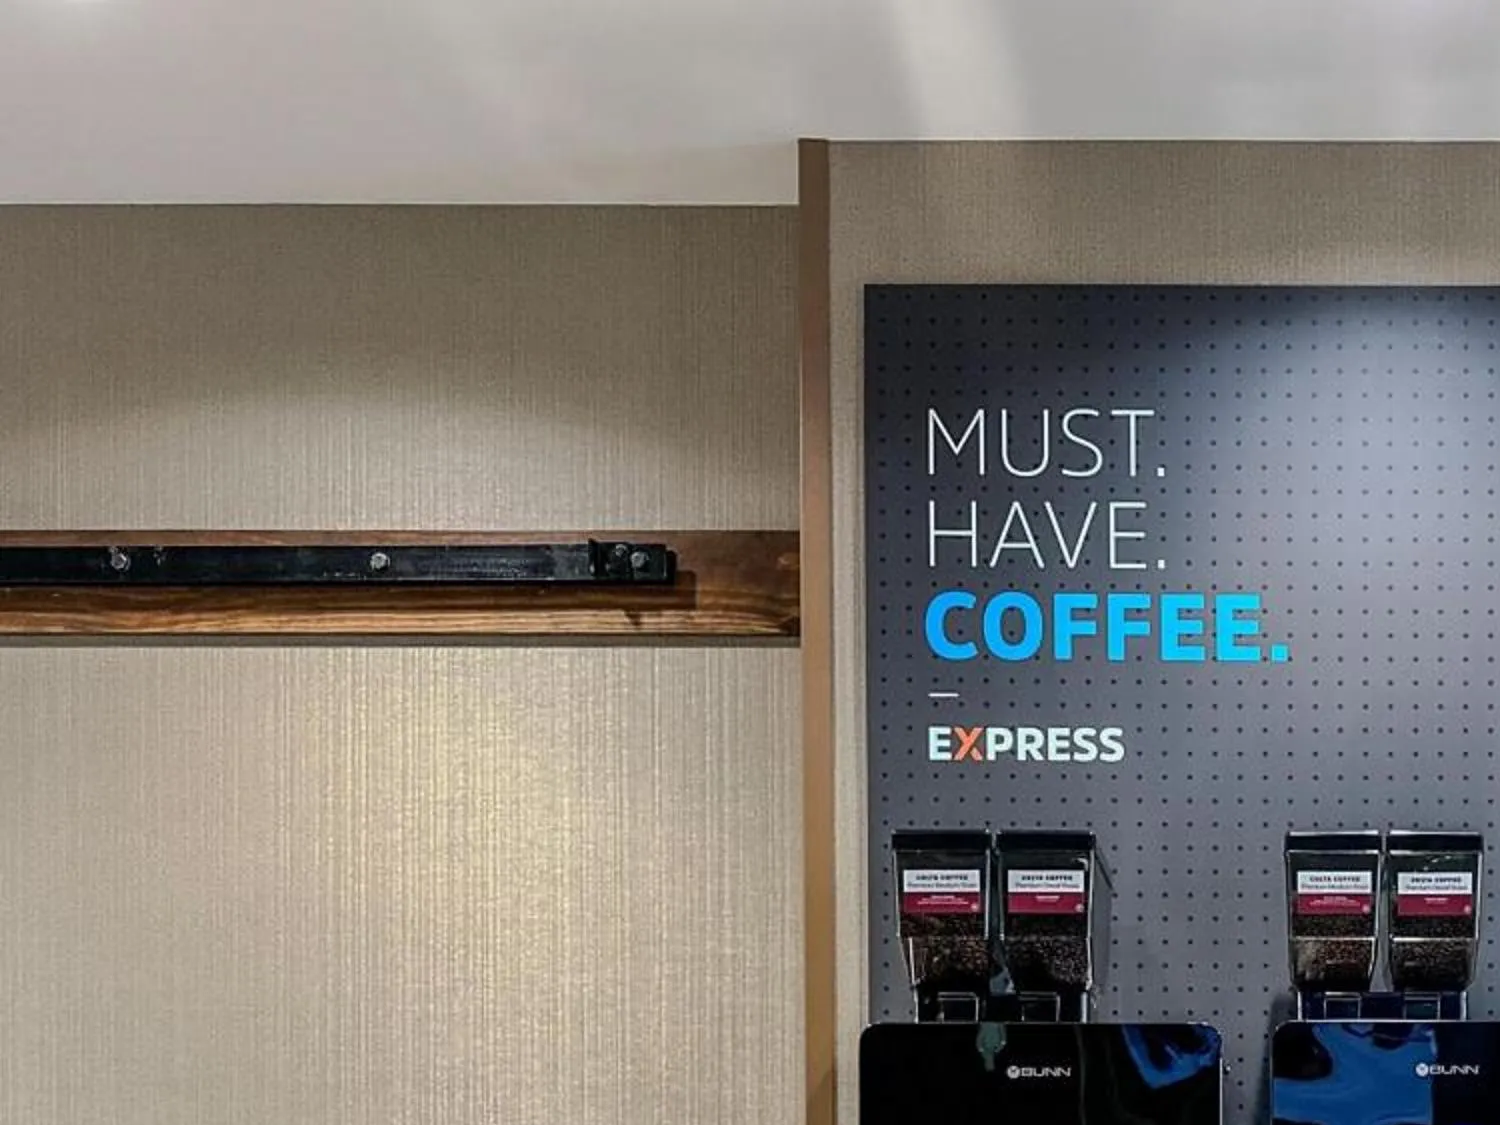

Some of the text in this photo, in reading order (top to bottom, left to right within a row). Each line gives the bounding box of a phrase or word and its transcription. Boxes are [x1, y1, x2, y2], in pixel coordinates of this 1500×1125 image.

[927, 407, 1167, 478] MUST.
[928, 499, 1167, 570] HAVE.
[924, 590, 1290, 662] COFFEE.
[927, 726, 1126, 762] EXPRESS
[1020, 1066, 1072, 1078] BUNN
[1428, 1063, 1480, 1076] BUNN
